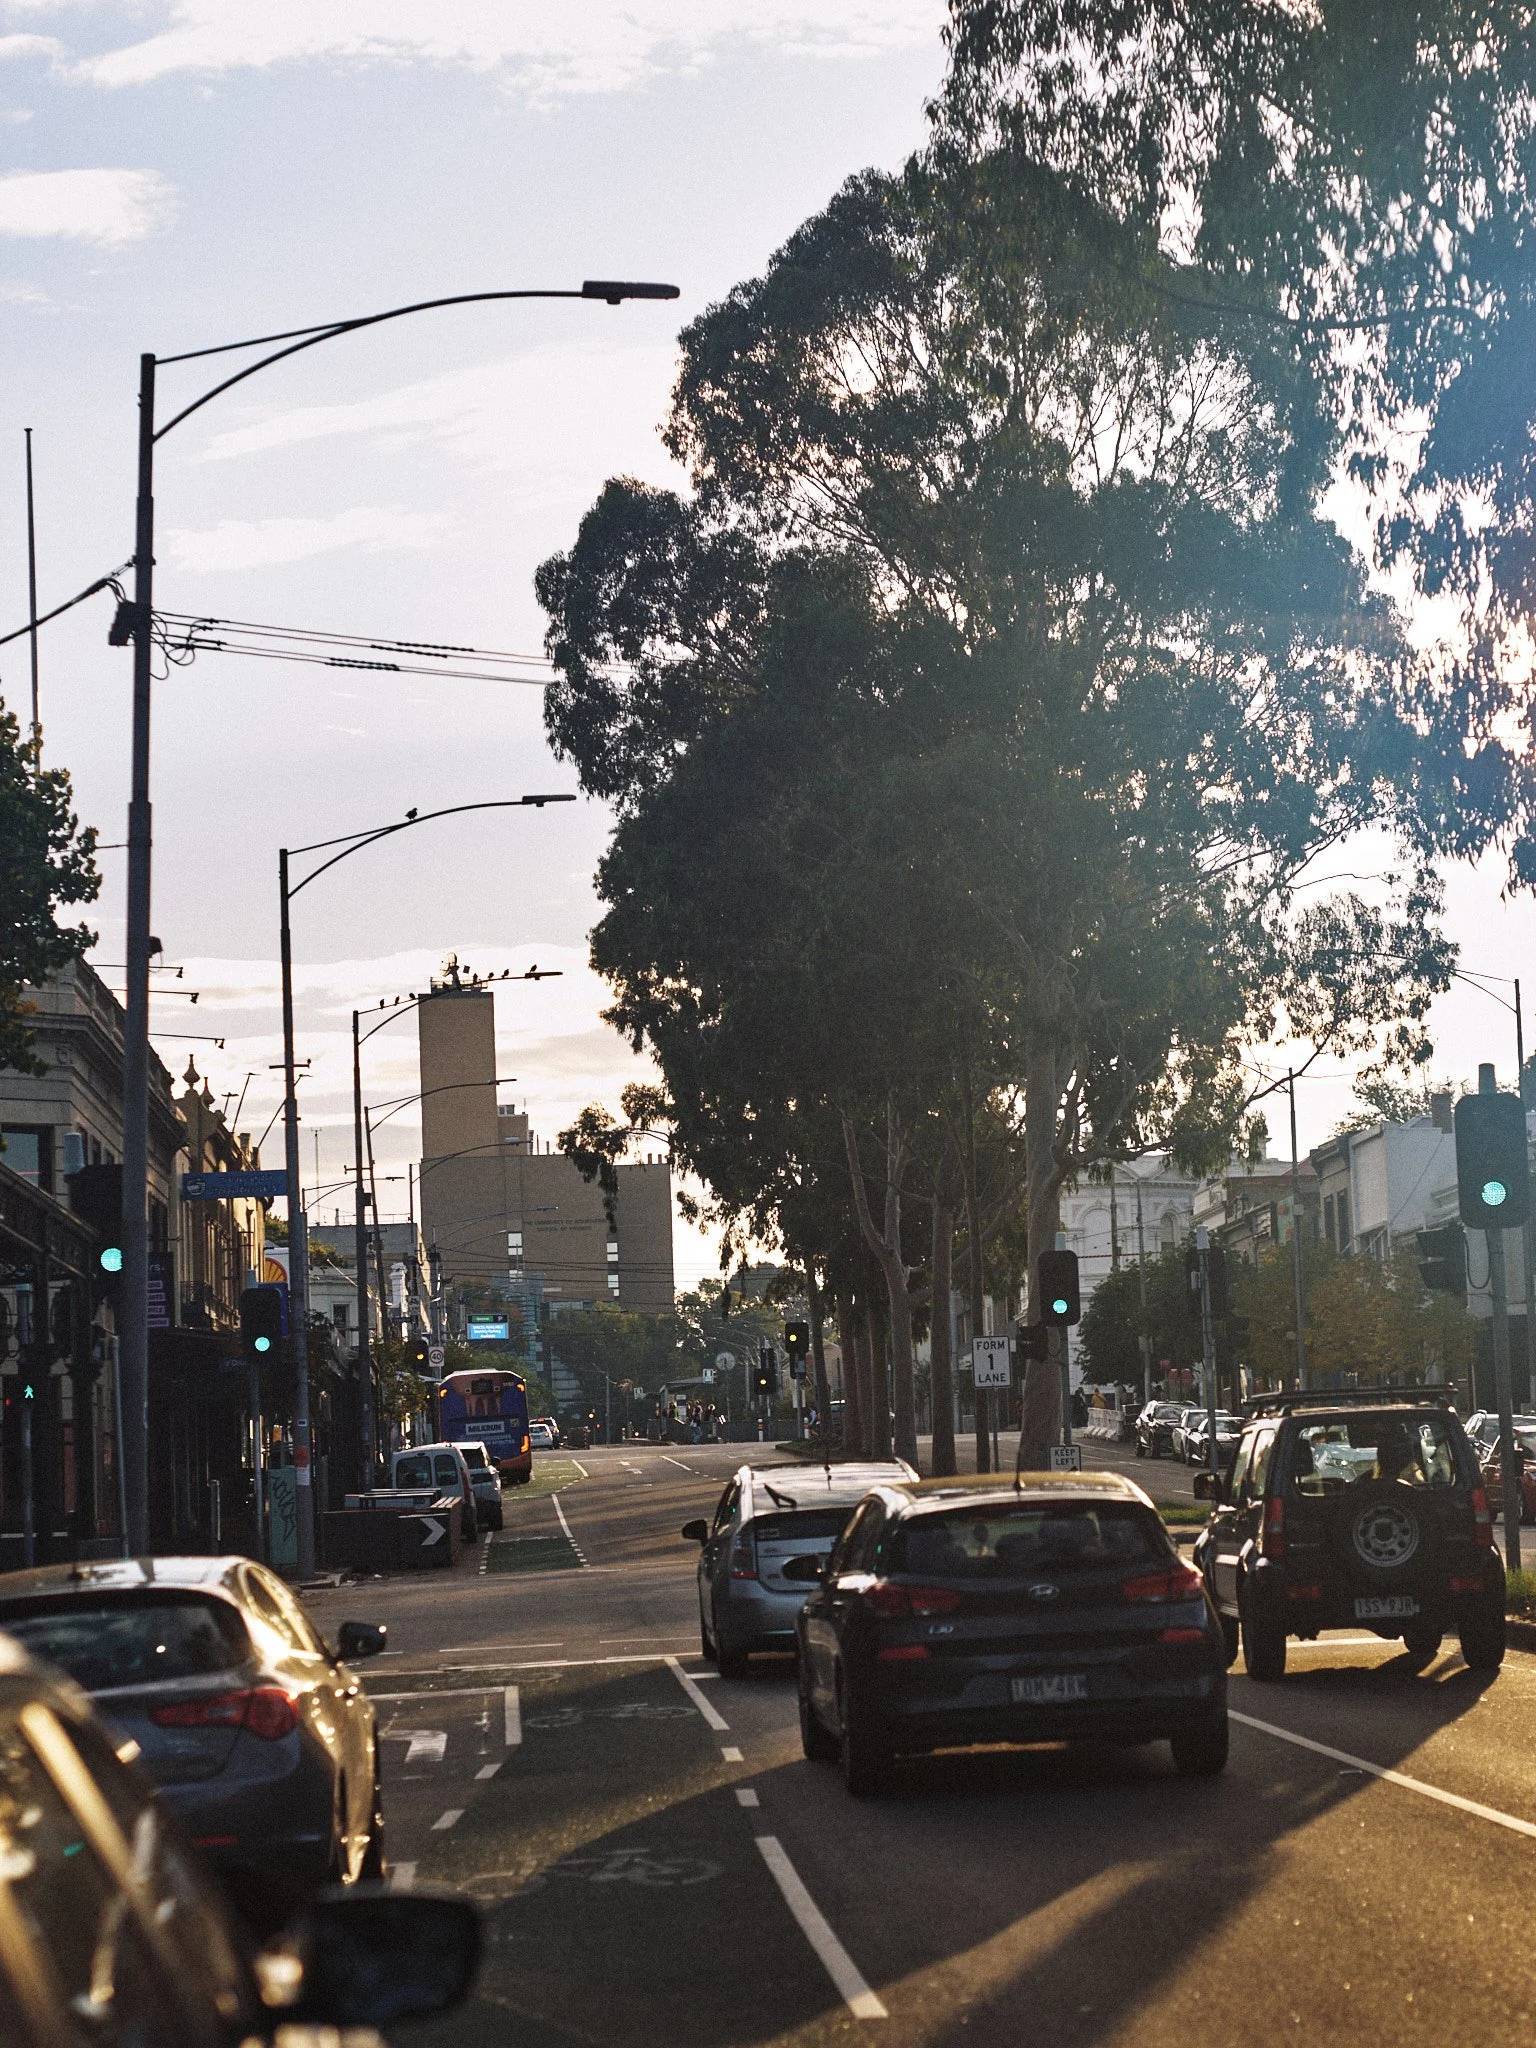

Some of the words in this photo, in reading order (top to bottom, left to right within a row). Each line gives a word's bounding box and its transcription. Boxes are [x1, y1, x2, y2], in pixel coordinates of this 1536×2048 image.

[976, 1340, 1005, 1350] FORM
[988, 1353, 994, 1370] 1
[978, 1373, 1006, 1383] LANE
[468, 1424, 502, 1432] MILKRUN
[1054, 1448, 1075, 1457] KEEP
[1055, 1457, 1075, 1466] LEFT
